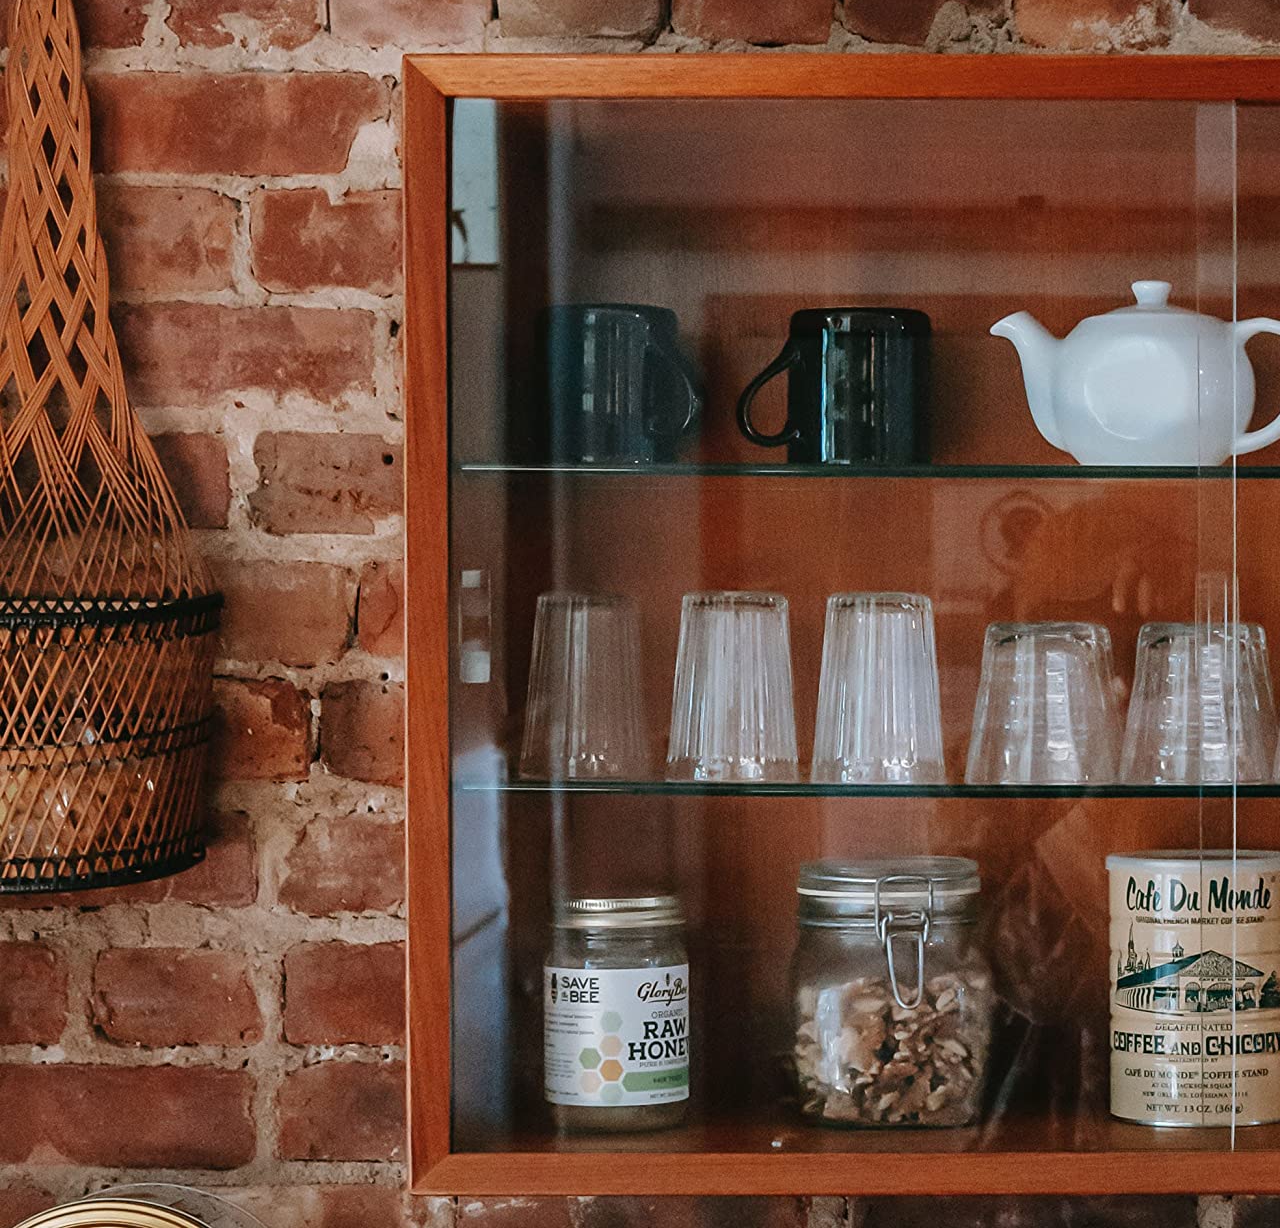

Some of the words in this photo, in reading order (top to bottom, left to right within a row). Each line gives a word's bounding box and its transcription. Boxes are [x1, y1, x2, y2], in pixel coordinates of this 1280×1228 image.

[1126, 875, 1163, 913] Café
[1170, 878, 1200, 912] Du
[1208, 876, 1271, 913] Monde
[1191, 917, 1219, 925] MARKET
[561, 976, 600, 990] SAVE
[569, 991, 600, 1004] BEE
[643, 1017, 687, 1040] RAW
[1155, 1022, 1233, 1032] DECAFFEINATED
[1113, 1030, 1166, 1055] COFFEE
[1170, 1041, 1201, 1056] AND
[1144, 1070, 1156, 1078] DU
[1241, 1068, 1270, 1078] STAND
[1146, 1103, 1163, 1112] NET
[1184, 1104, 1195, 1114] 13
